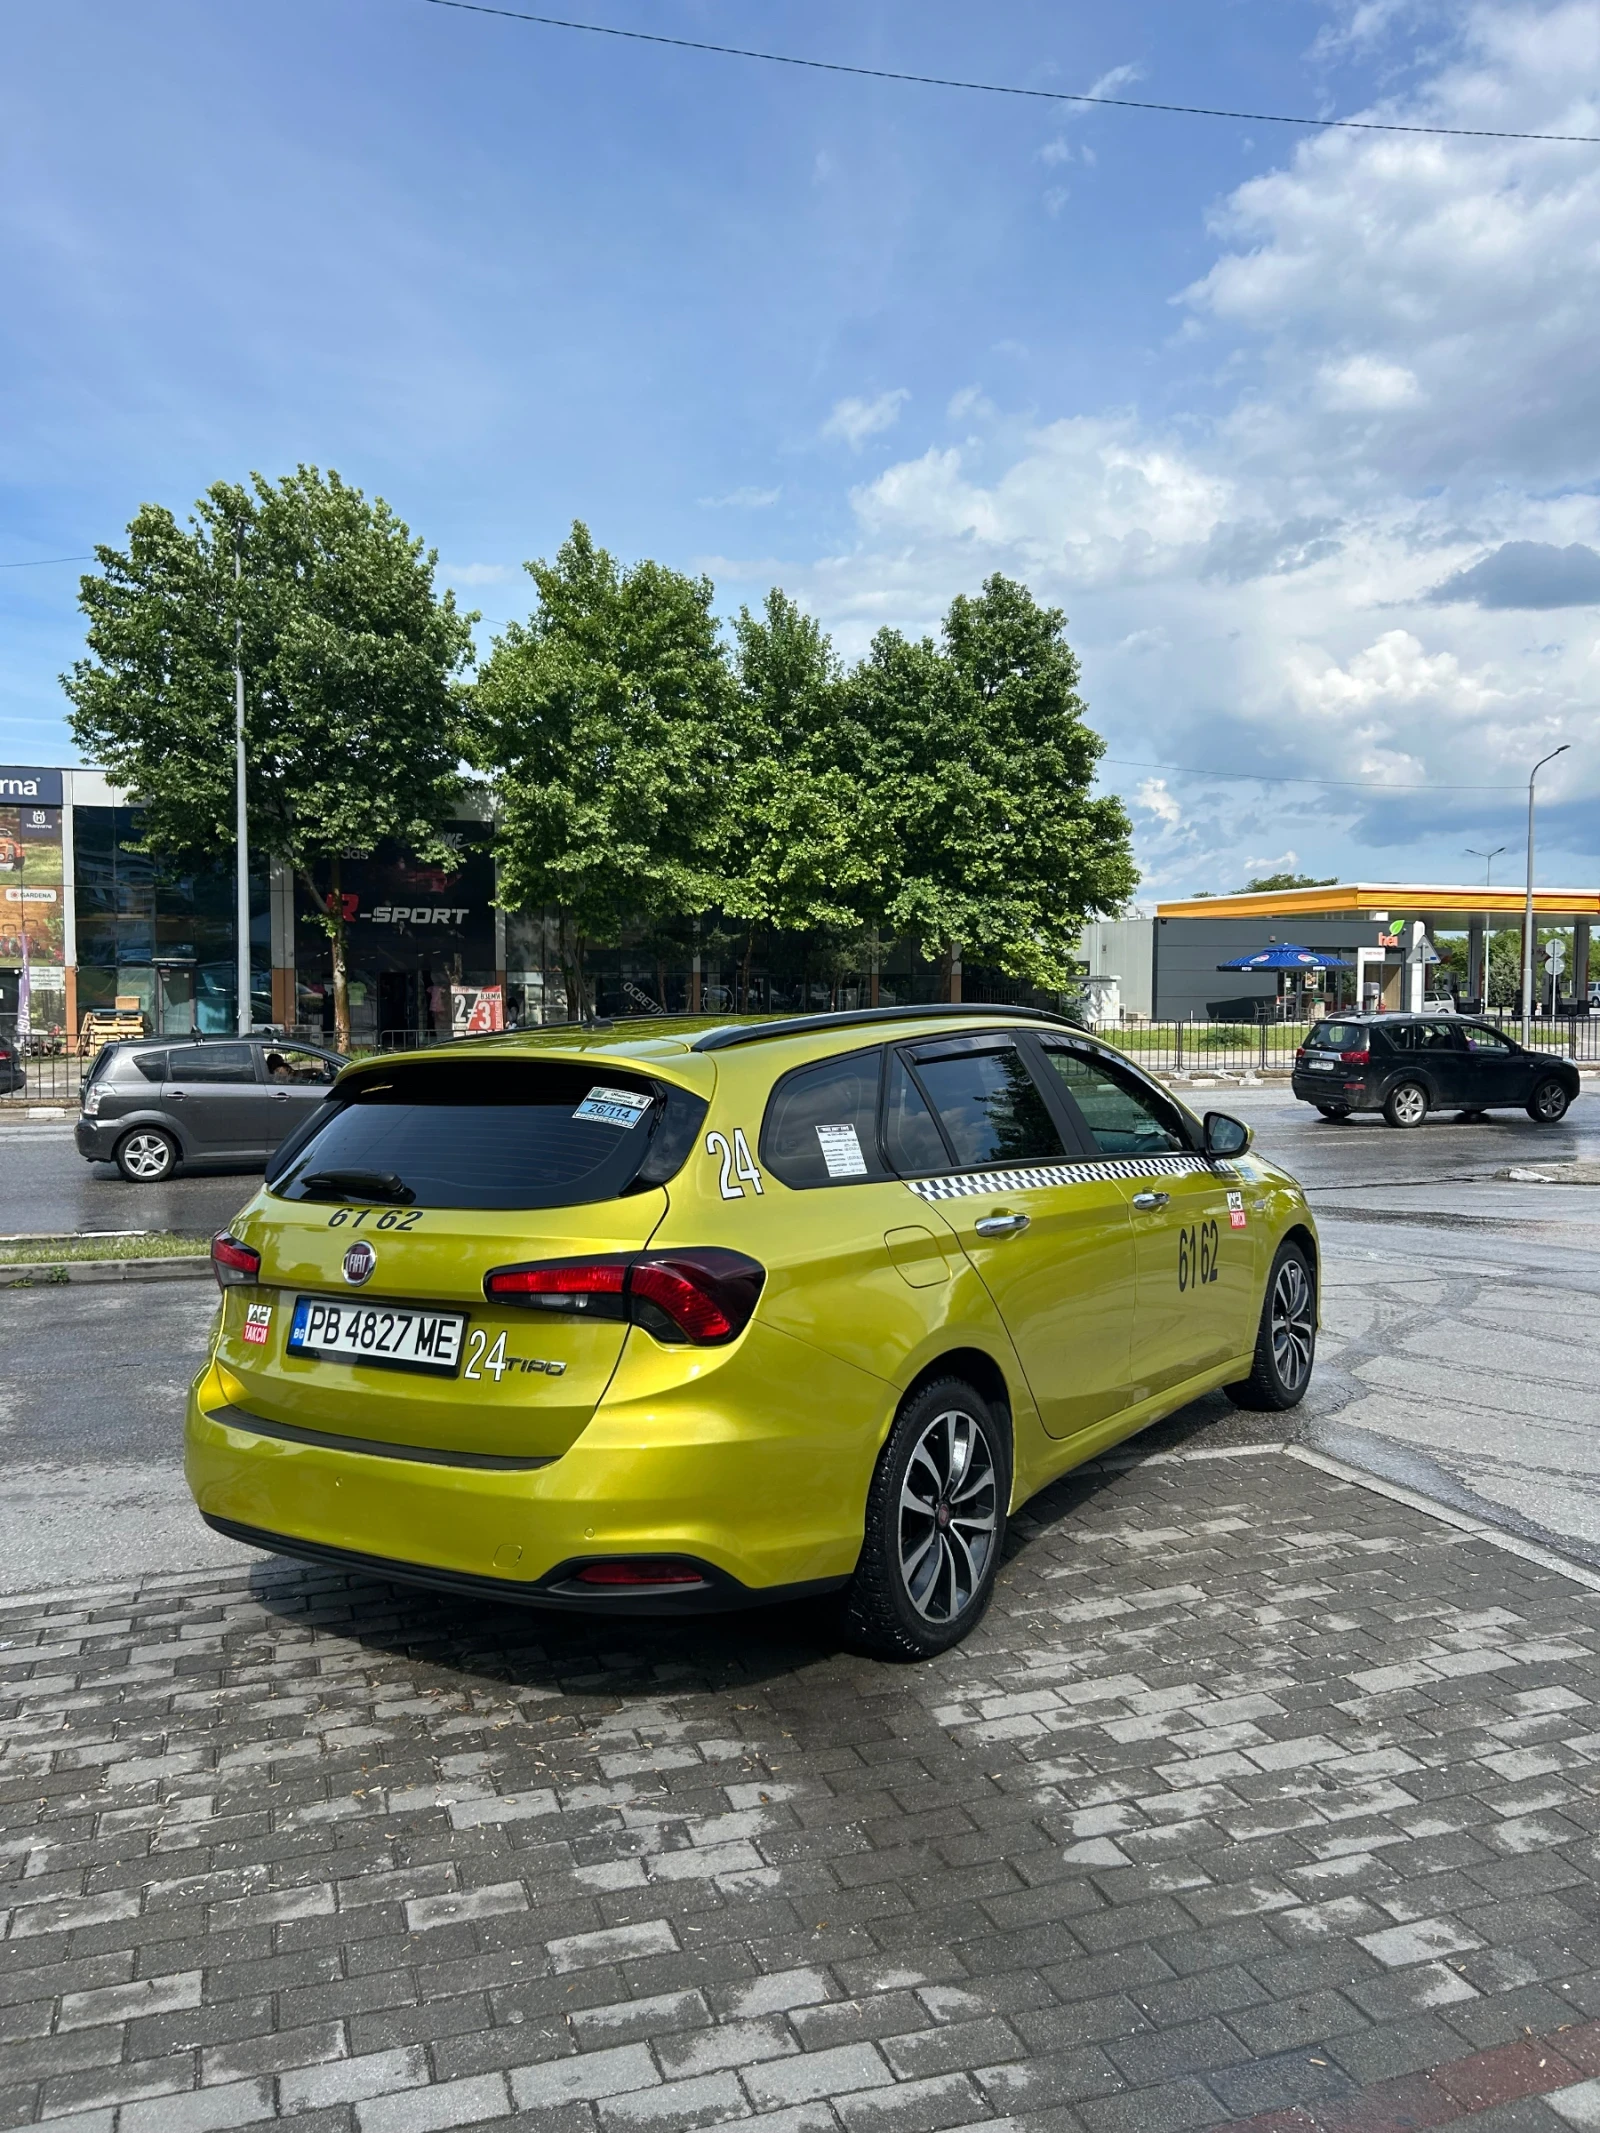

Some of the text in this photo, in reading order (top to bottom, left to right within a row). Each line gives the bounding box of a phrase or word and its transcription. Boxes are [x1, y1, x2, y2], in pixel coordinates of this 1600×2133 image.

[588, 1103, 632, 1119] 26/114
[705, 1127, 764, 1201] 24
[349, 1253, 368, 1273] FIAT
[244, 1324, 268, 1344] ТАКСИ
[293, 1327, 305, 1340] BG
[307, 1305, 456, 1359] PB 4827 ME
[464, 1328, 508, 1382] 24
[505, 1357, 567, 1376] TIPO
